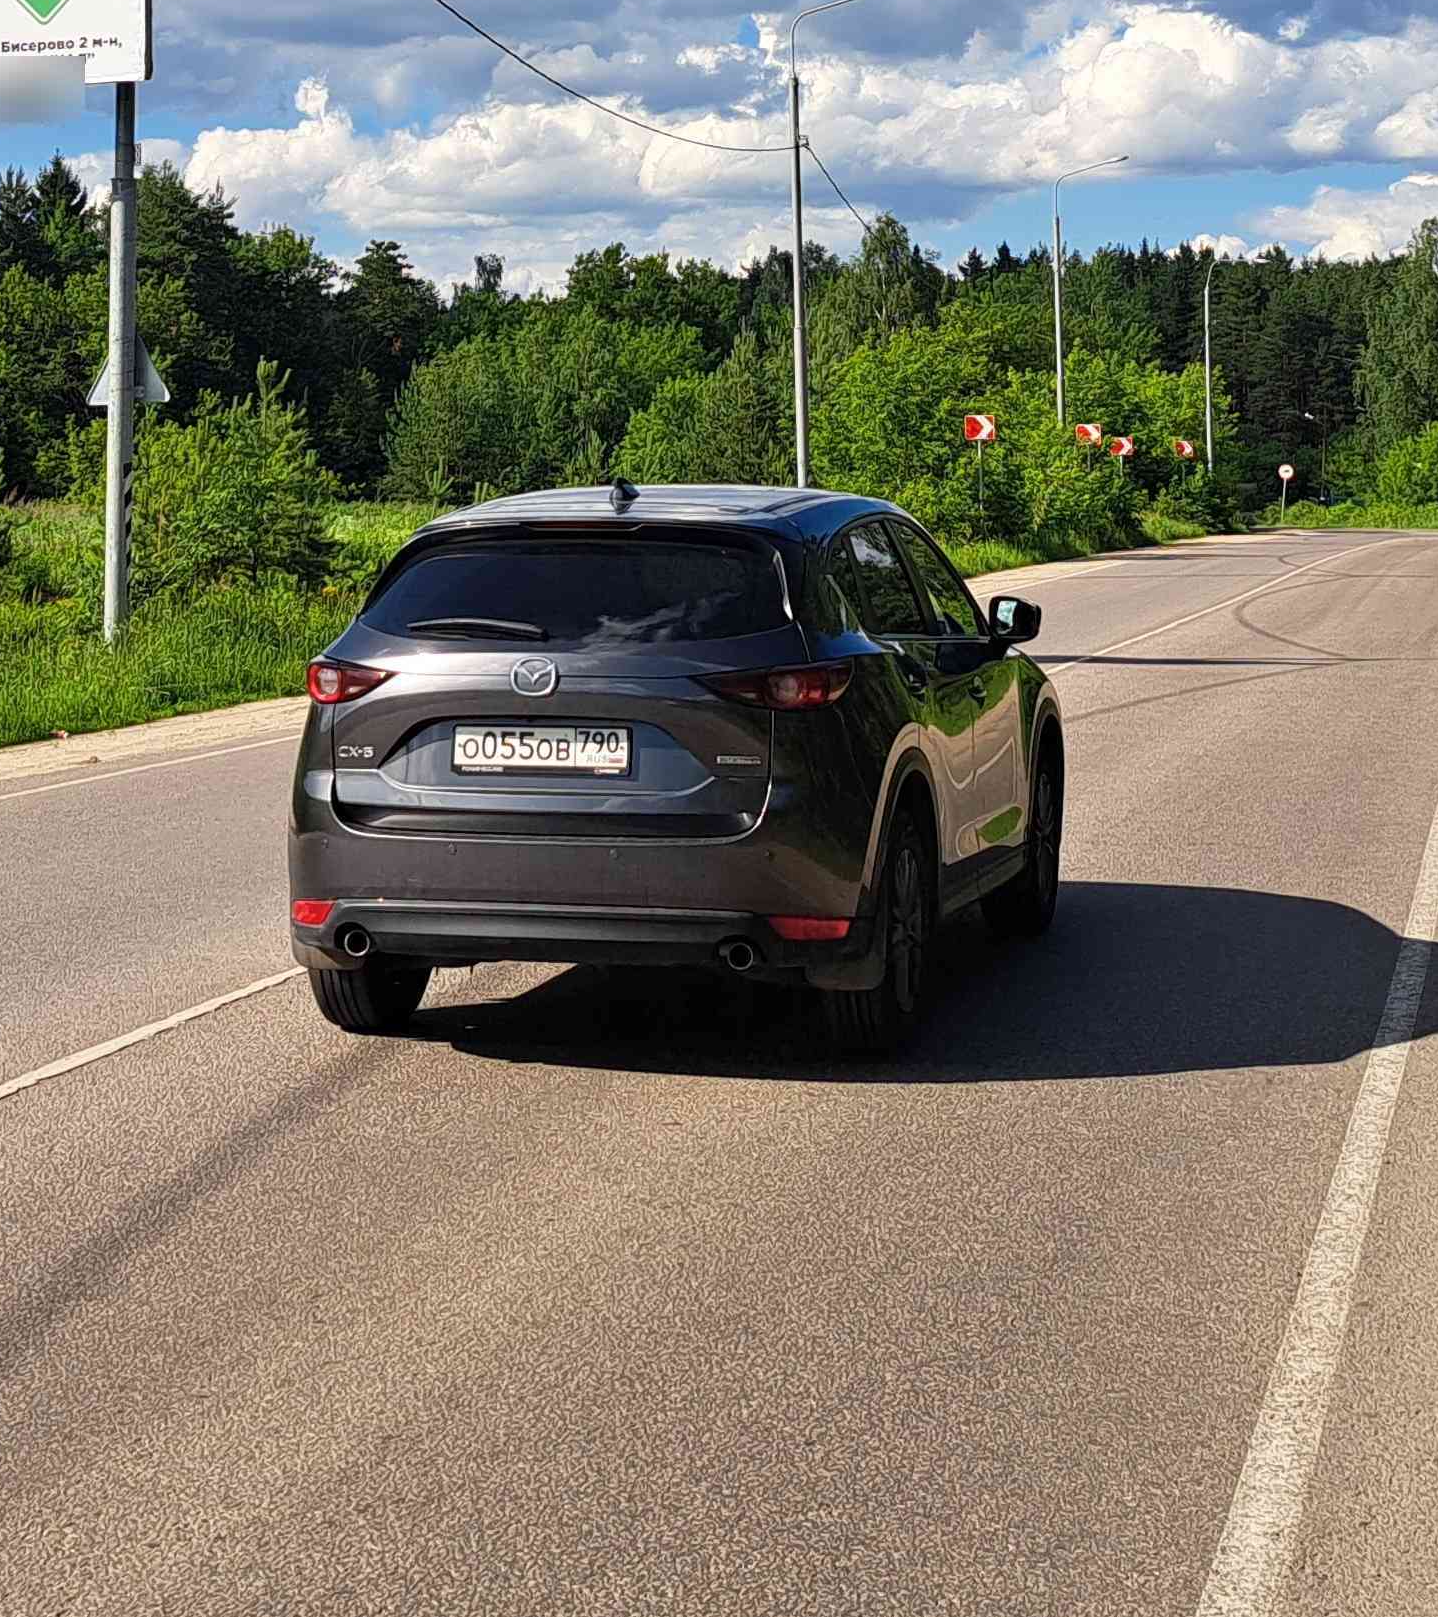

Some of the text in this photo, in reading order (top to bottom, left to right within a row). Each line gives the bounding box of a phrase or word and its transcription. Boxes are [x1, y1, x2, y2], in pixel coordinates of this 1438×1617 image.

[1, 39, 75, 54] Бисерово
[78, 37, 88, 49] 2
[578, 730, 620, 753] 790
[338, 745, 374, 758] CX-5
